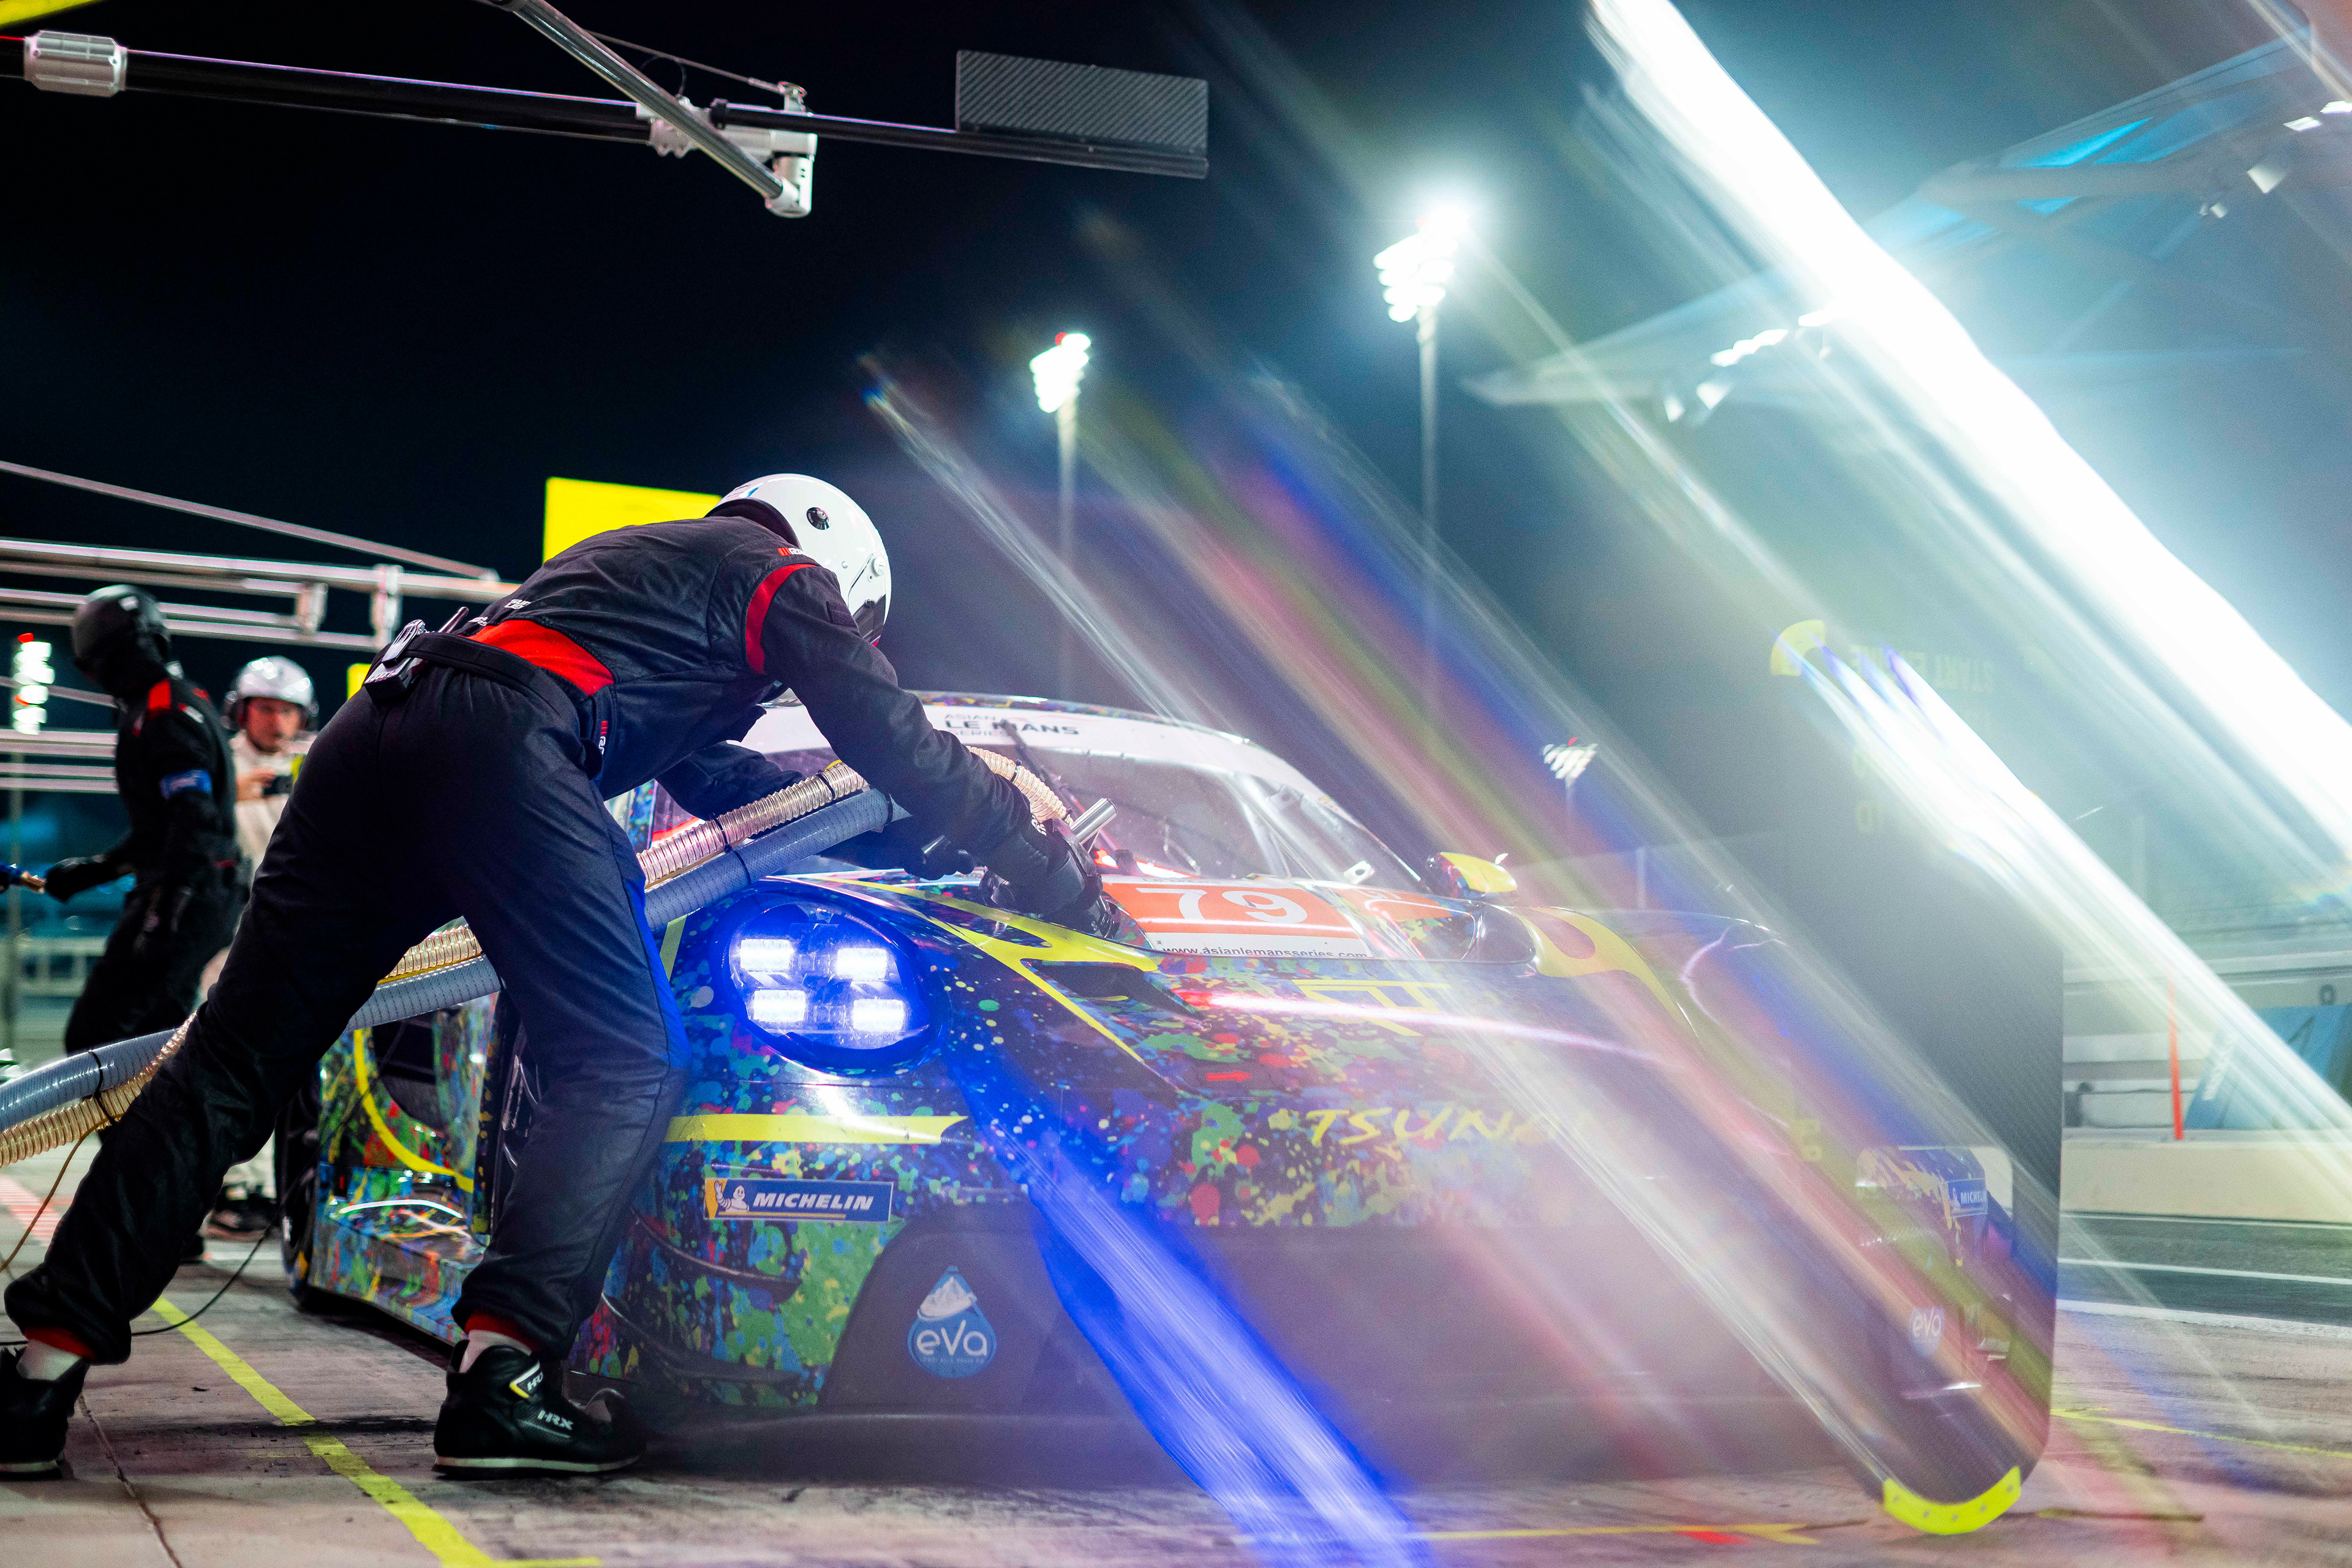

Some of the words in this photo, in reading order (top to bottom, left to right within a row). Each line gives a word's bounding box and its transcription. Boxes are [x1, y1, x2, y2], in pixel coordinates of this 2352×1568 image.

[946, 720, 980, 729] LE
[1135, 887, 1308, 924] 79
[753, 1192, 874, 1211] MICHELIN
